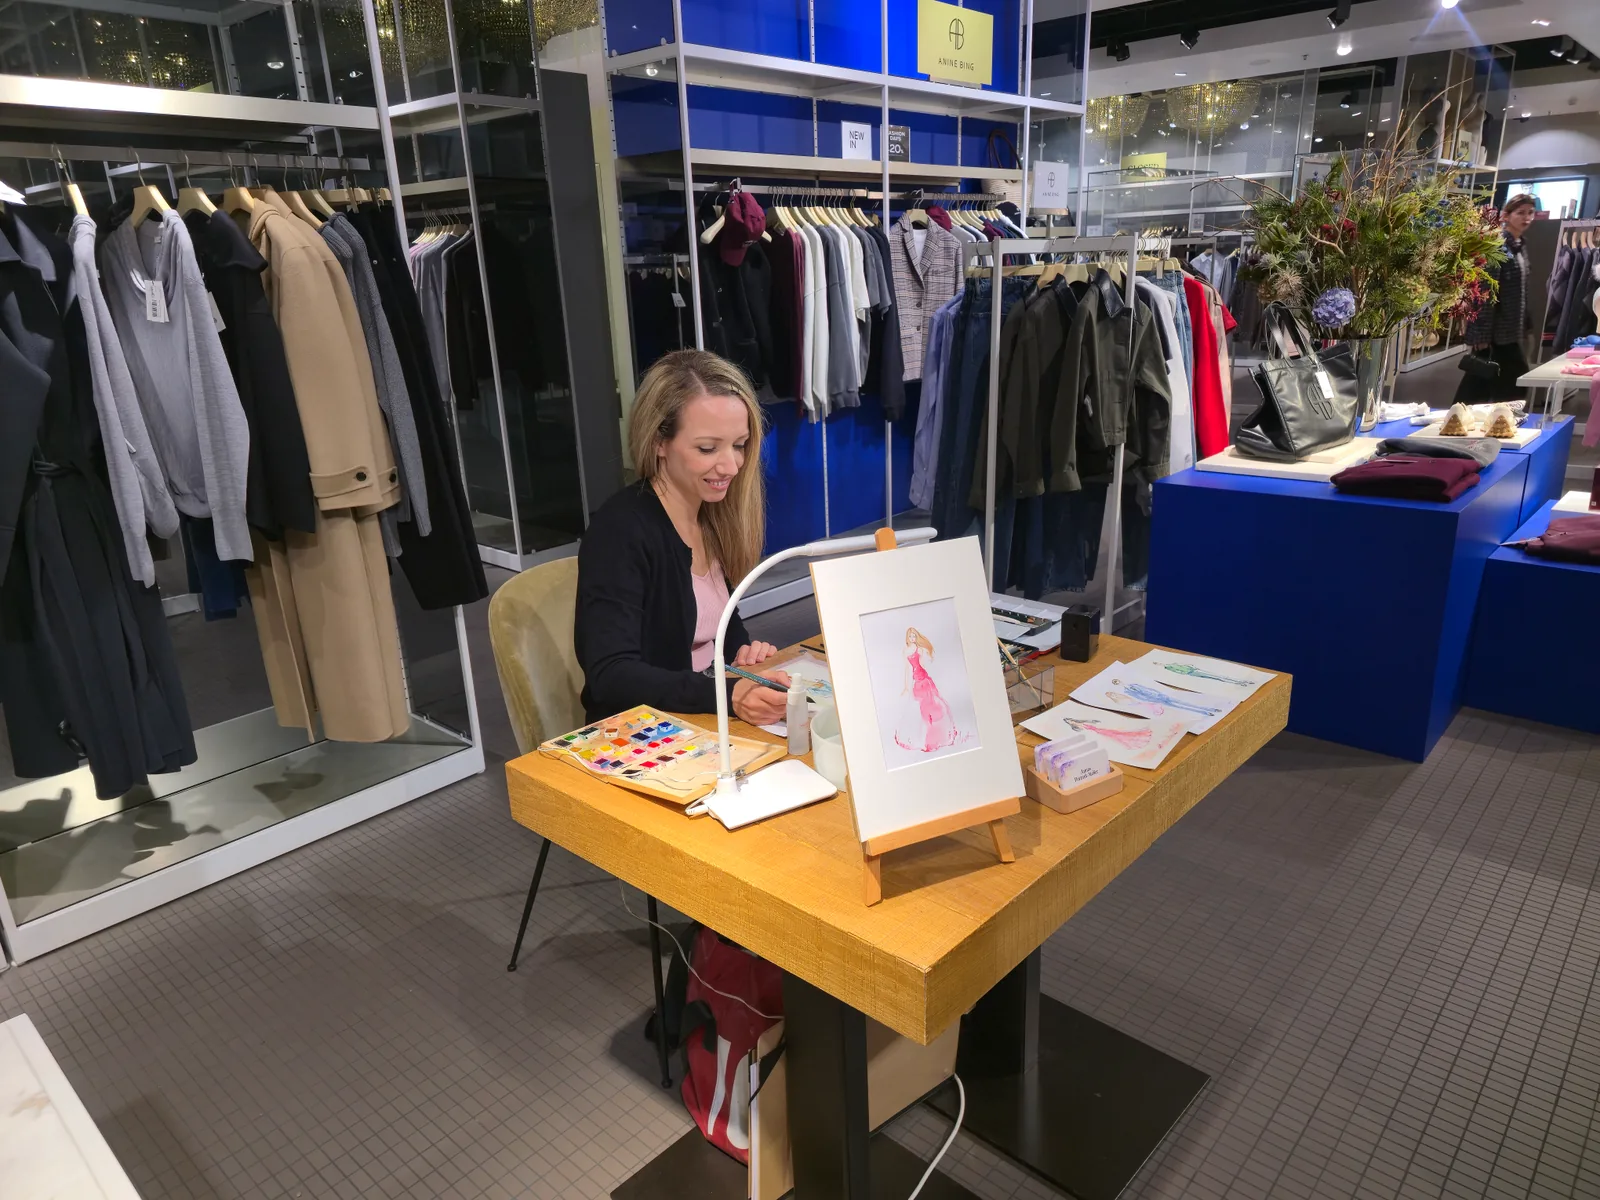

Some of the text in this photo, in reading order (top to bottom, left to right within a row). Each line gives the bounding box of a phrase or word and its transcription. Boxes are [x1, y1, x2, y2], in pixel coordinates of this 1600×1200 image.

[938, 57, 975, 71] ANINE BING
[849, 130, 864, 140] NEW
[849, 140, 857, 149] IN
